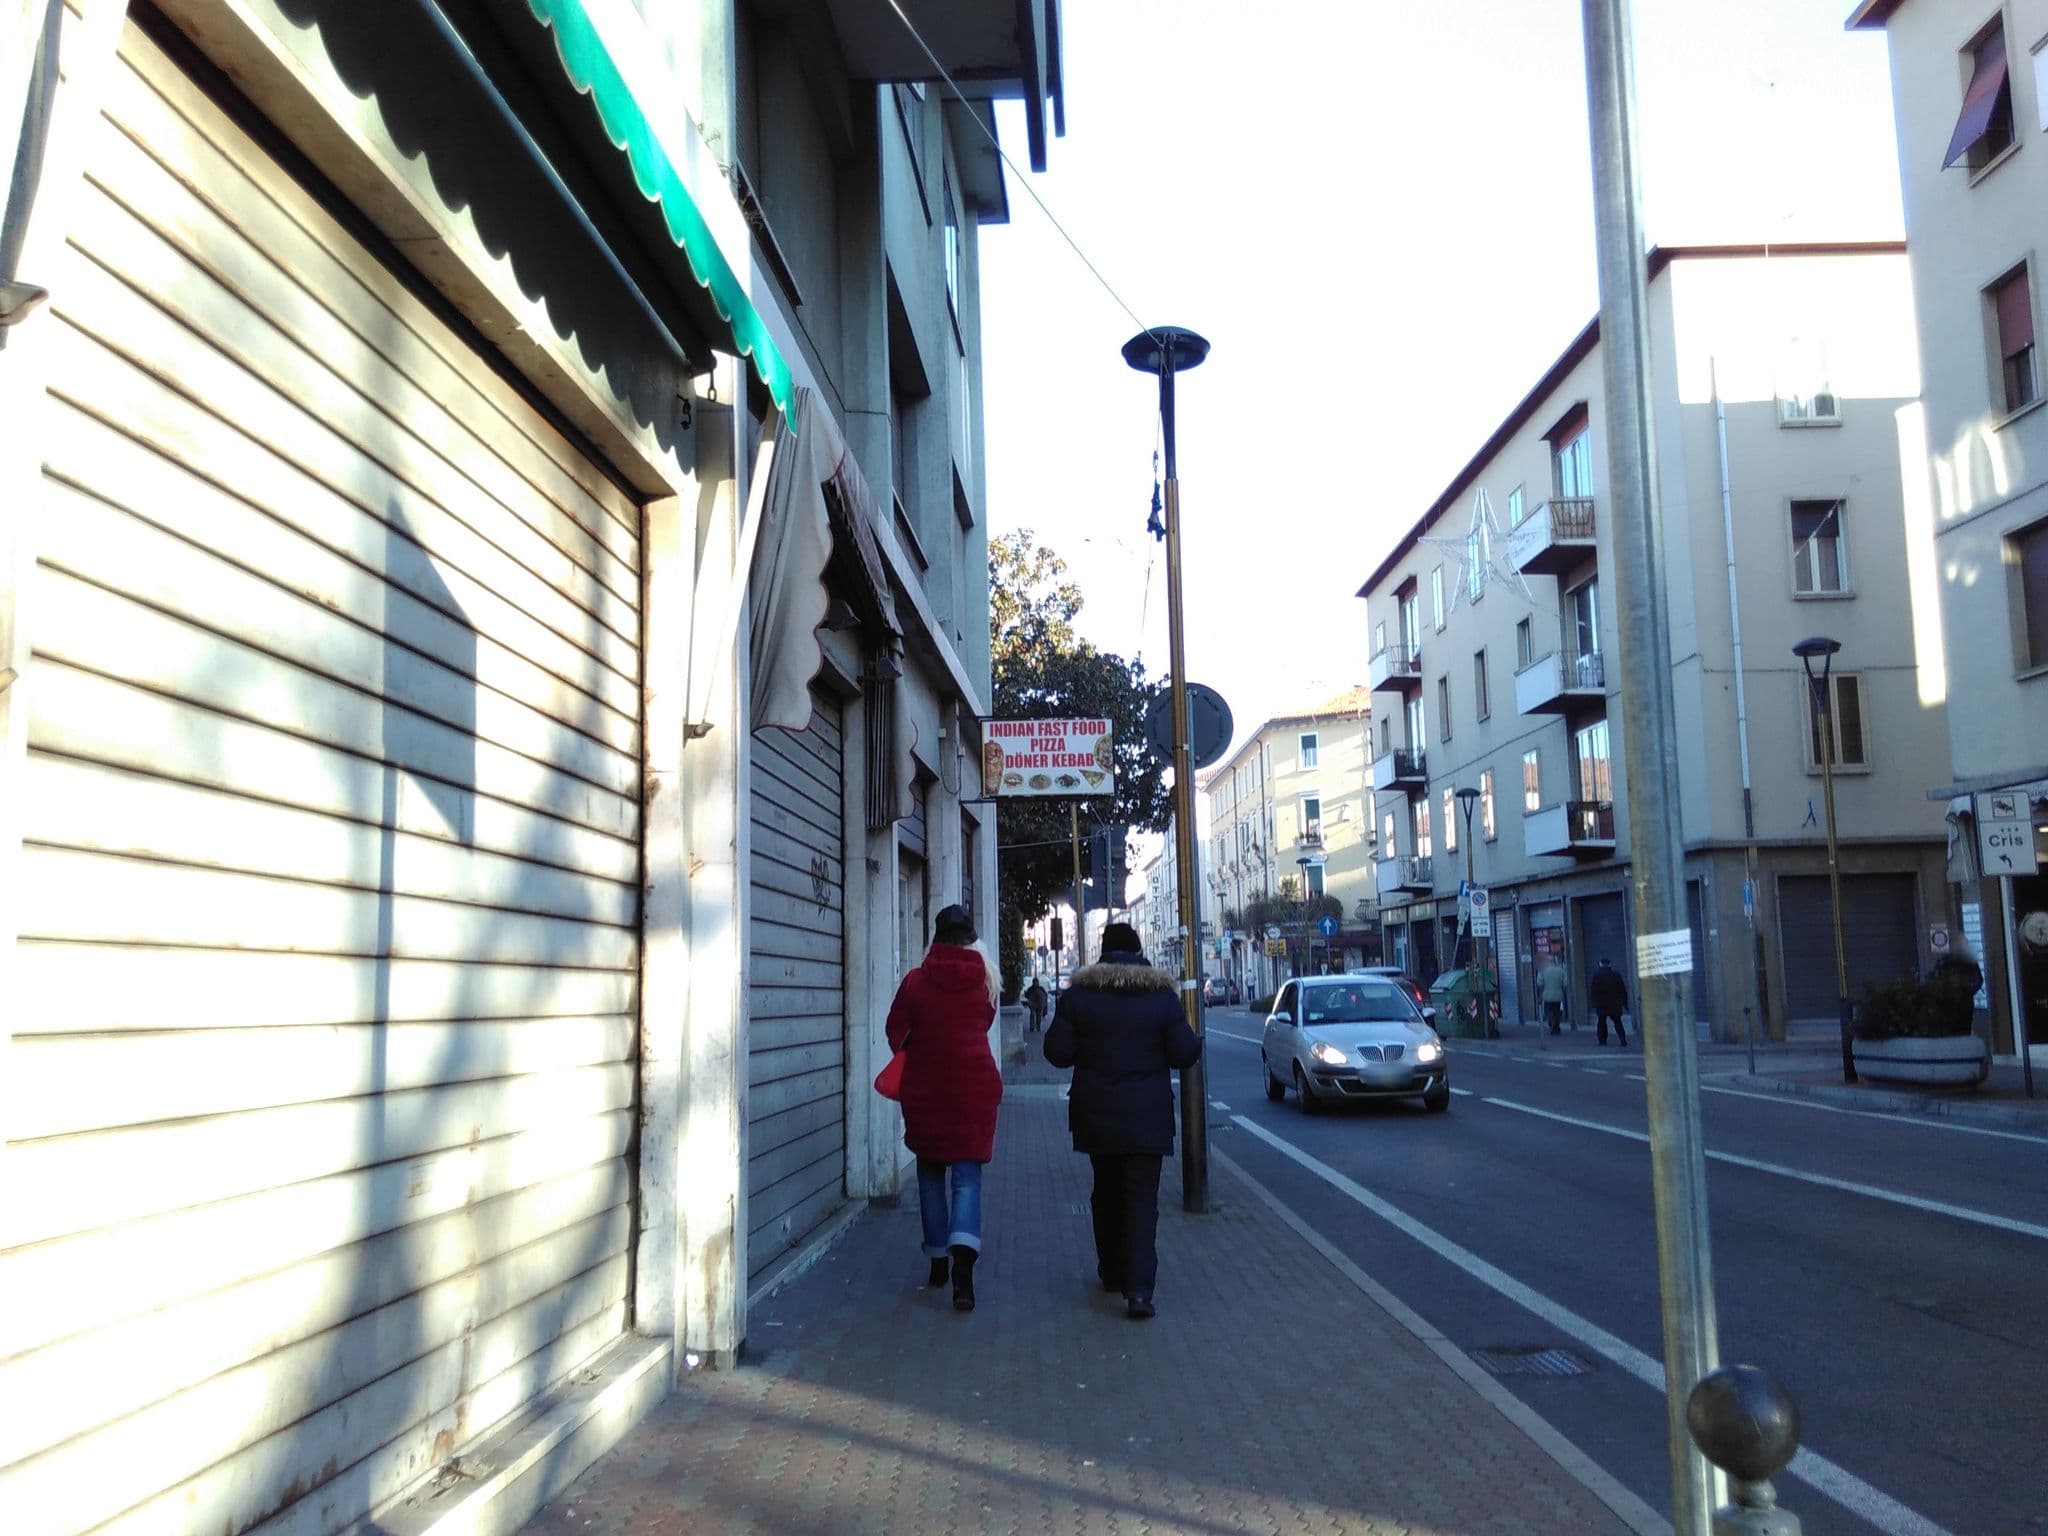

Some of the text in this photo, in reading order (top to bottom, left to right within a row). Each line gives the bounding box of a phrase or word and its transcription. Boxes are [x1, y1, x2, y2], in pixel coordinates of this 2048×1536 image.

[989, 721, 1106, 737] INDIAN FAST FOOD
[1030, 738, 1065, 752] PIZZA
[1005, 752, 1095, 769] DÖNER KEBAB
[1988, 834, 2024, 848] Cris
